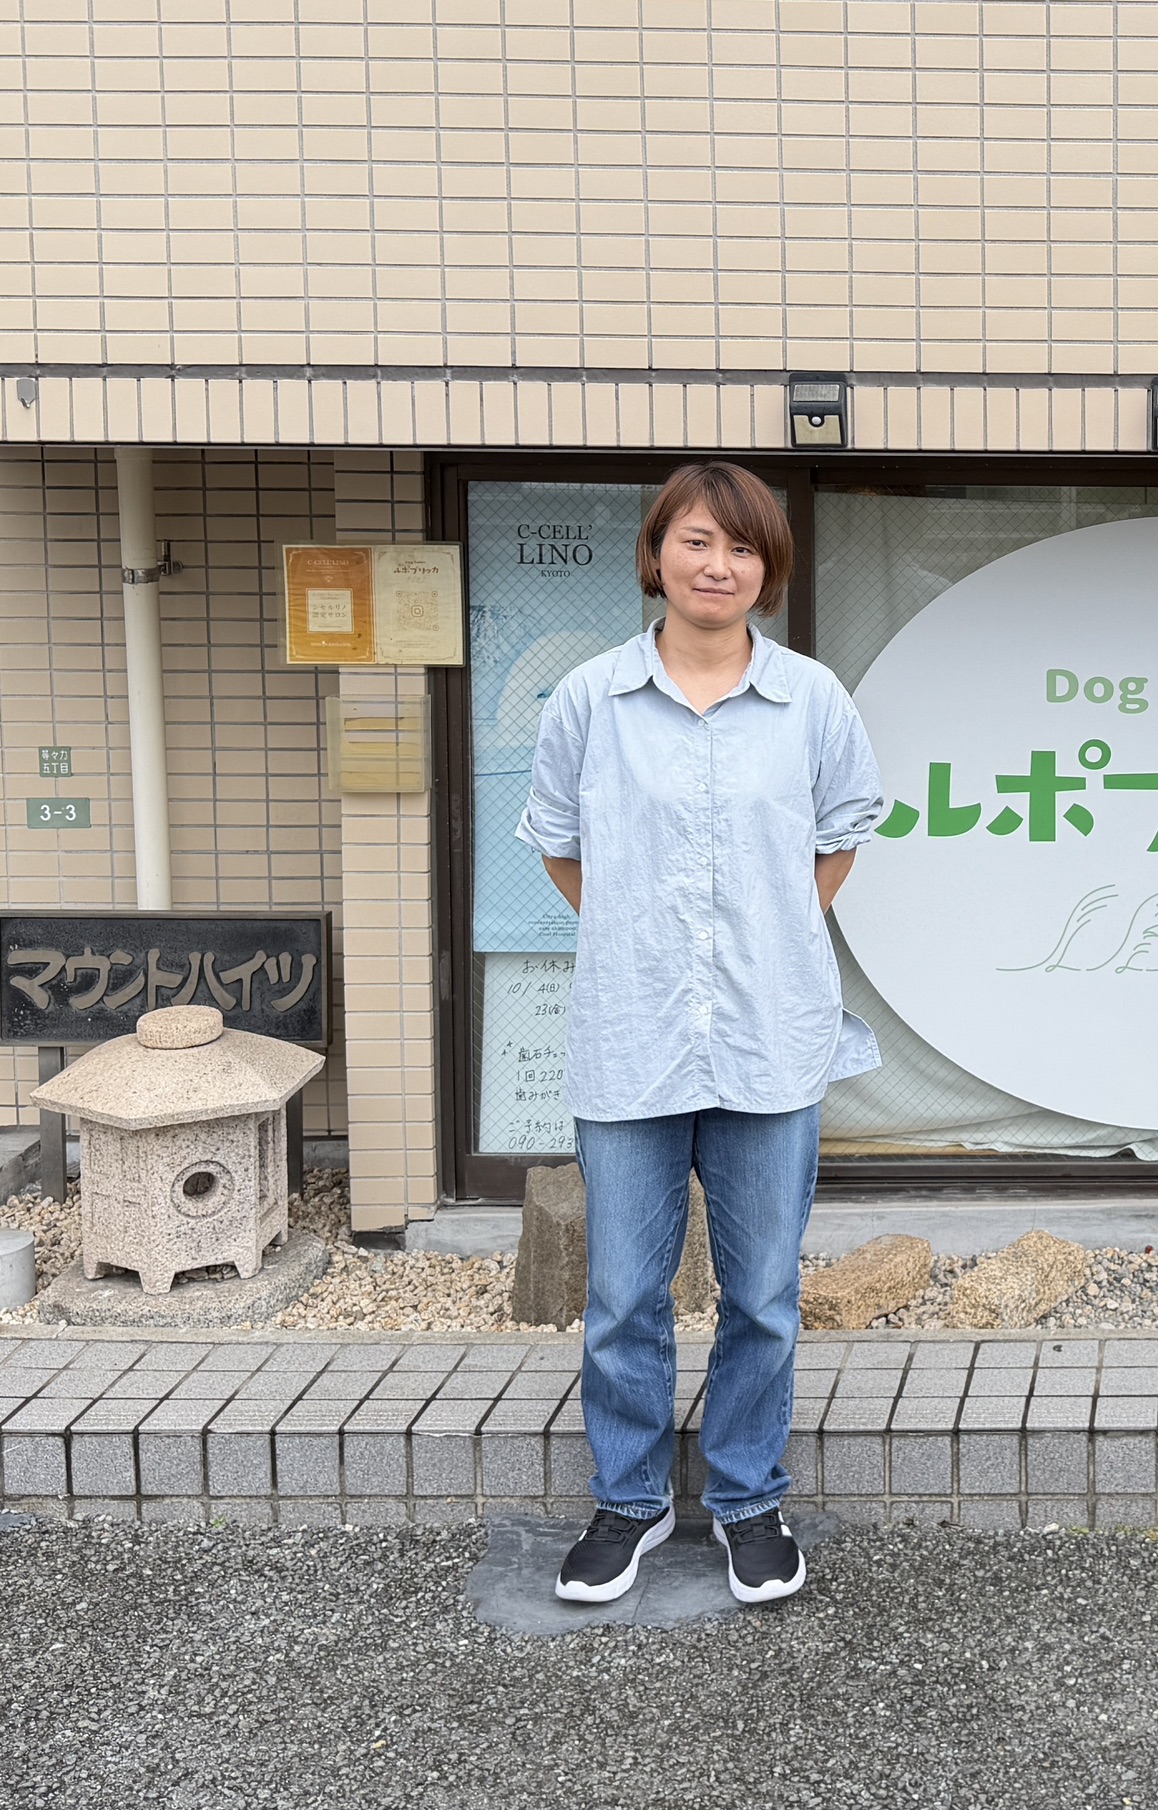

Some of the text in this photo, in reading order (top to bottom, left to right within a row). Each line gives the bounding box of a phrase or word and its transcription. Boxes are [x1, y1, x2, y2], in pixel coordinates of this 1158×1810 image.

[517, 543, 593, 566] LINO
[541, 570, 570, 578] KYOTO
[1046, 668, 1149, 714] Dog
[42, 749, 68, 761] 等々力
[43, 762, 69, 774] 五丁目
[40, 804, 76, 821] 3-3
[522, 959, 575, 974] お休み
[7, 947, 316, 1012] マウントハイツ
